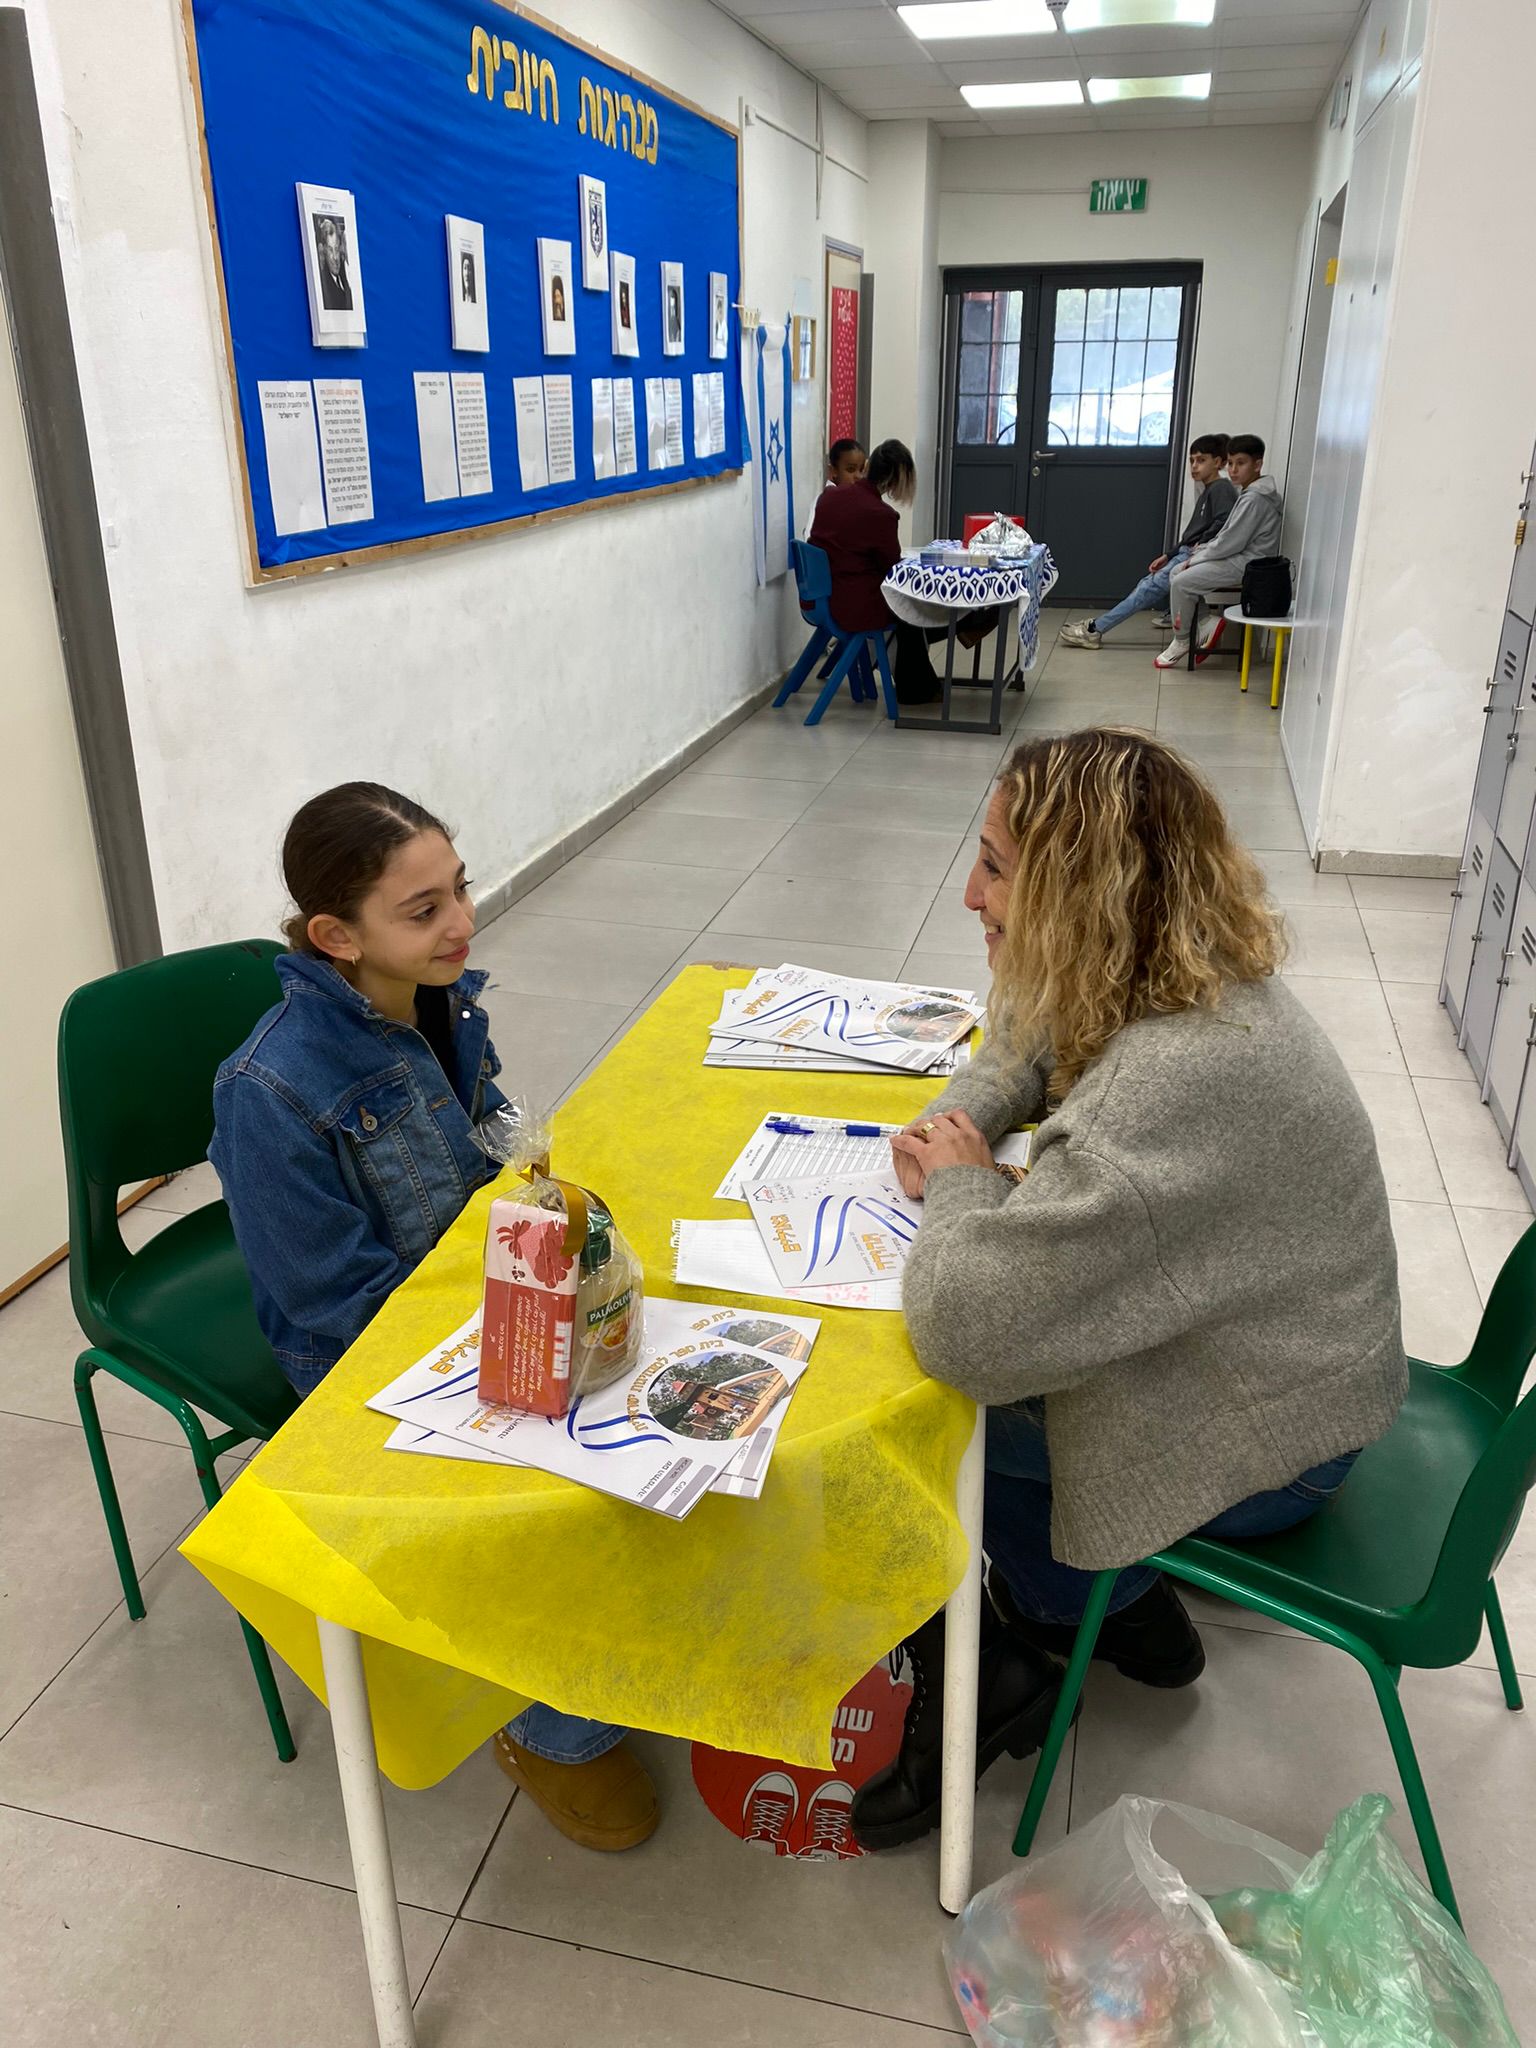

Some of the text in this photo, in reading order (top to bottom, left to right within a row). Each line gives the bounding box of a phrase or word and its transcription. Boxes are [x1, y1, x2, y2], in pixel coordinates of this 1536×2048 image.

[467, 26, 659, 165] מנהיגות חיובית
[1097, 180, 1140, 211] יציאה
[712, 1310, 736, 1322] בית
[669, 1344, 696, 1358] ספר
[699, 1340, 724, 1350] בית
[497, 1417, 524, 1439] ראשונה
[662, 1460, 673, 1471] שם
